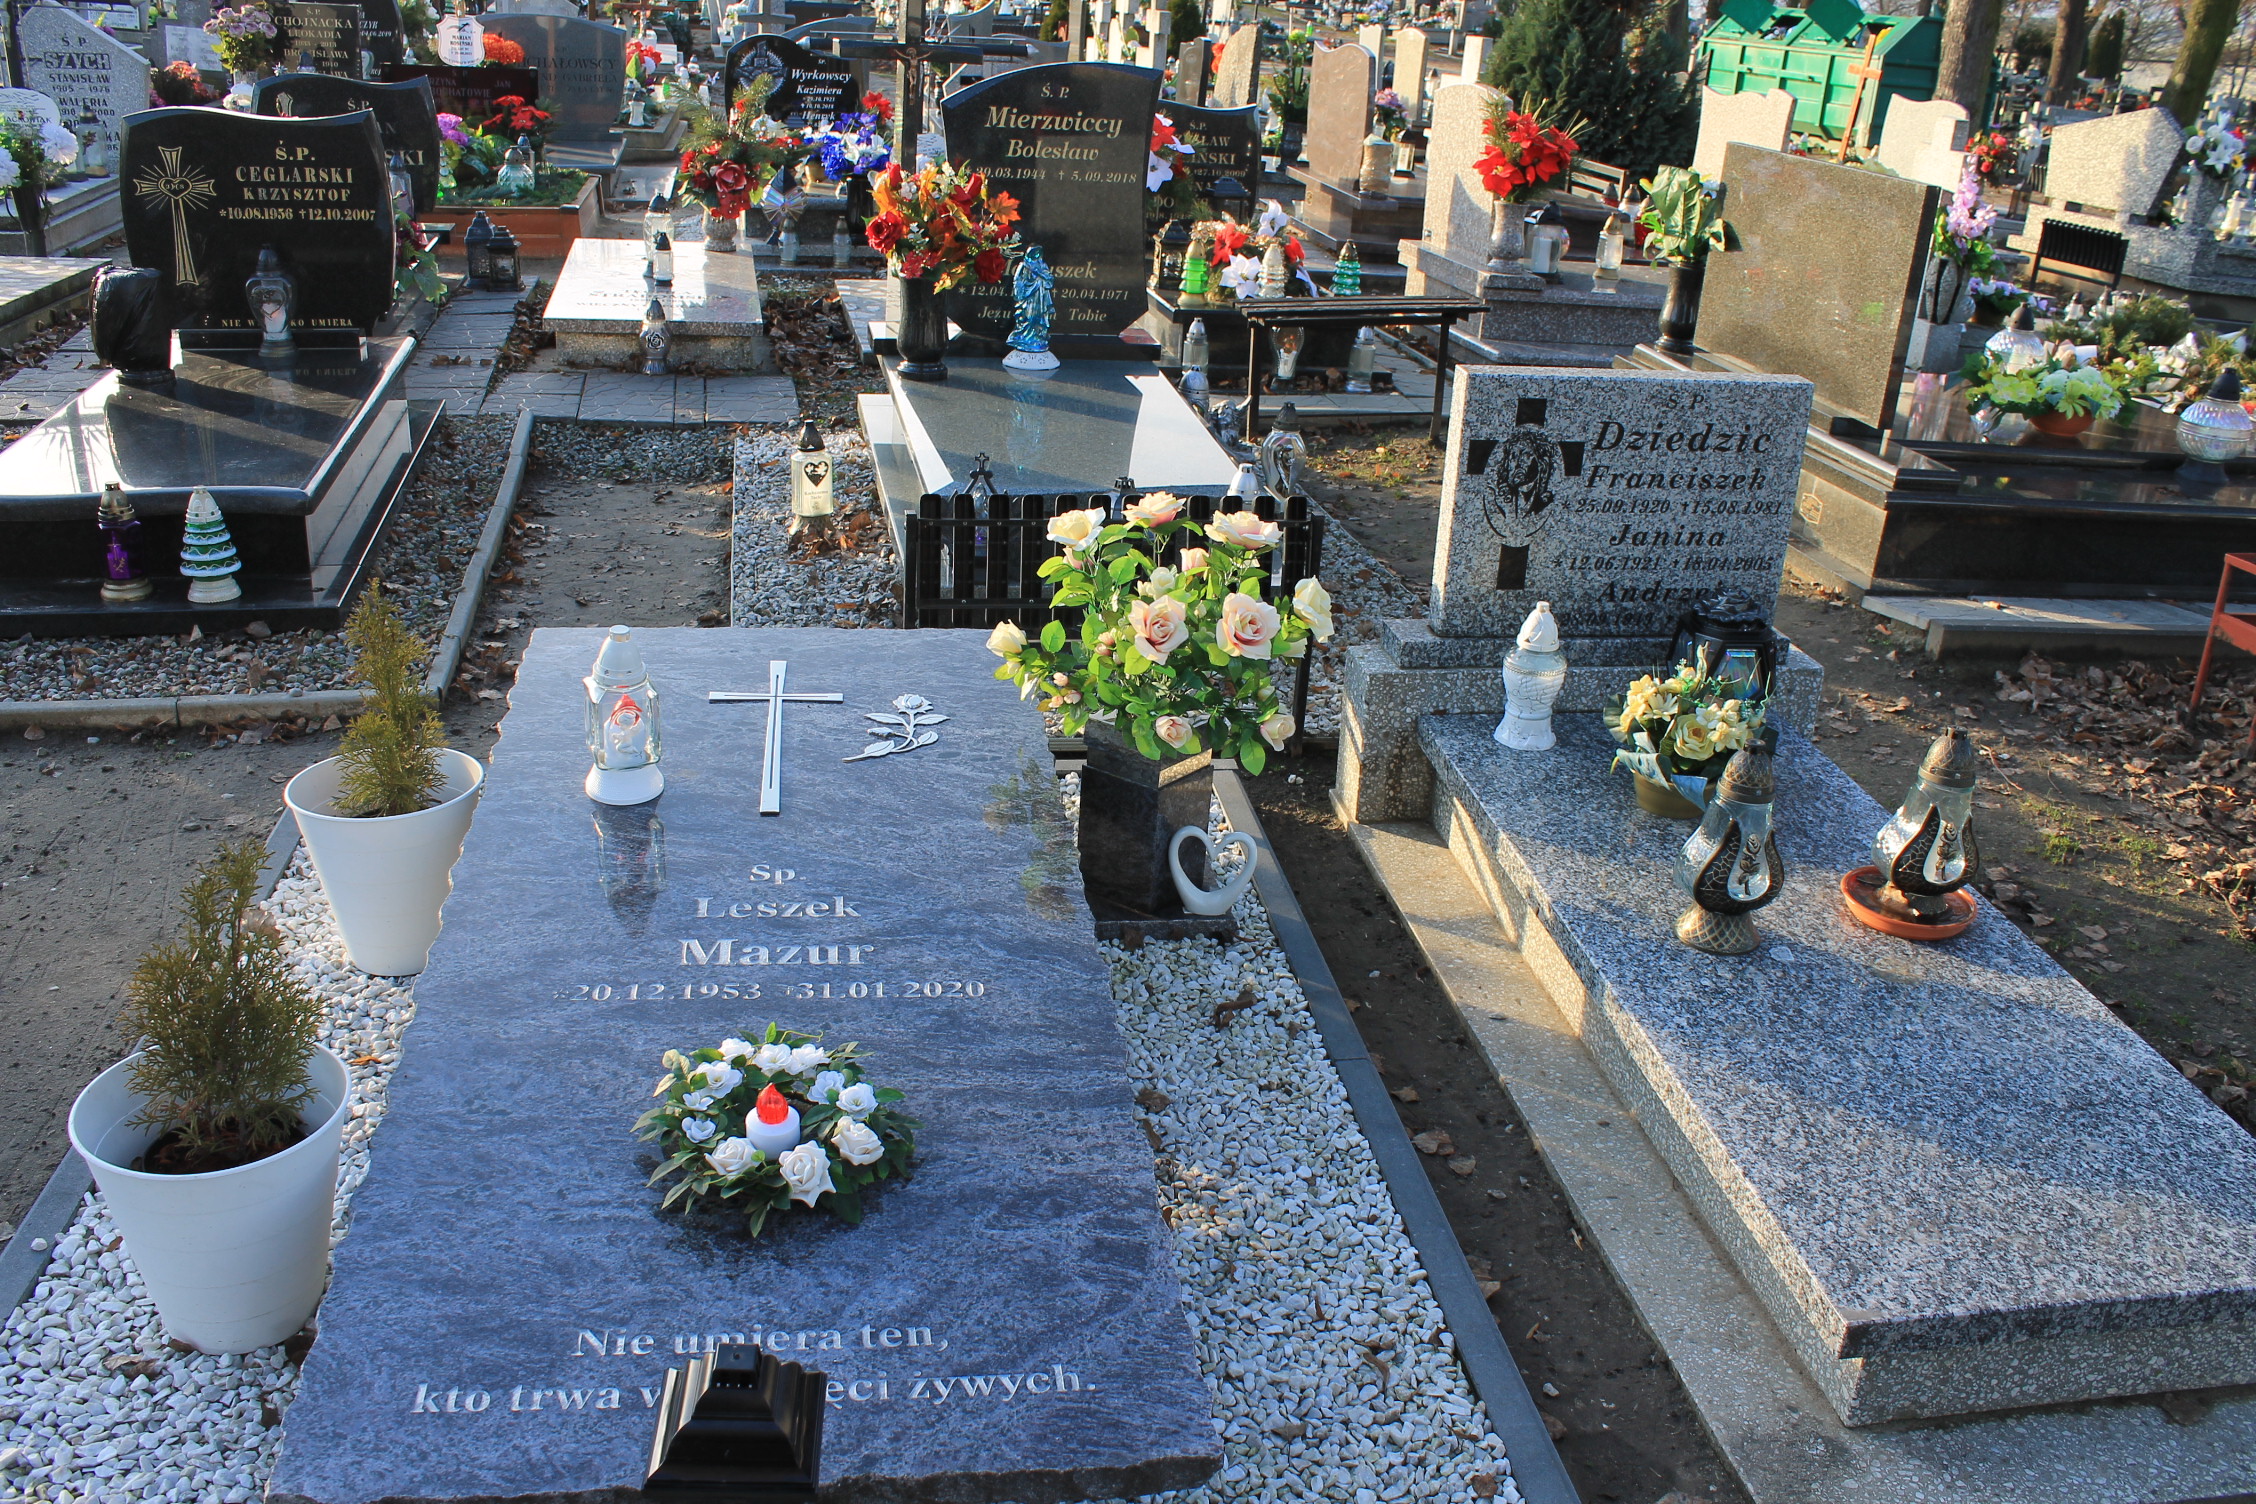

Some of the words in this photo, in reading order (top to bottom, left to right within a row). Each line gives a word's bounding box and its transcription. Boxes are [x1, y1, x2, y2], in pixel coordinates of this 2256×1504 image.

[274, 16, 353, 29] CHOJNACKA
[288, 30, 342, 39] LEOKADIA
[44, 51, 111, 70] SZYCH
[49, 73, 111, 84] STANISŁAW
[791, 68, 852, 83] Wyrkowscy
[796, 85, 842, 95] Kazimiera
[984, 105, 1123, 139] Mierzwiccy
[1005, 139, 1099, 161] Bolesław
[235, 166, 353, 184] CEGLARSKI
[243, 187, 351, 202] KRZYSZTOF
[222, 319, 241, 327] NIE
[311, 318, 353, 327] UMIERA
[1069, 308, 1107, 322] Tobie
[1592, 421, 1772, 453] Dziedzic
[1584, 465, 1767, 491] Franciszek
[1609, 524, 1725, 547] Janina
[1596, 580, 1725, 602] Andrze
[694, 896, 862, 919] Leszek
[678, 938, 875, 966] Mazur
[571, 1328, 655, 1357] Nie
[674, 1323, 843, 1357] umiera
[861, 1324, 949, 1354] ten,
[411, 1382, 491, 1414] kto
[496, 1382, 622, 1413] trwa
[909, 1363, 1098, 1405] żywych.
